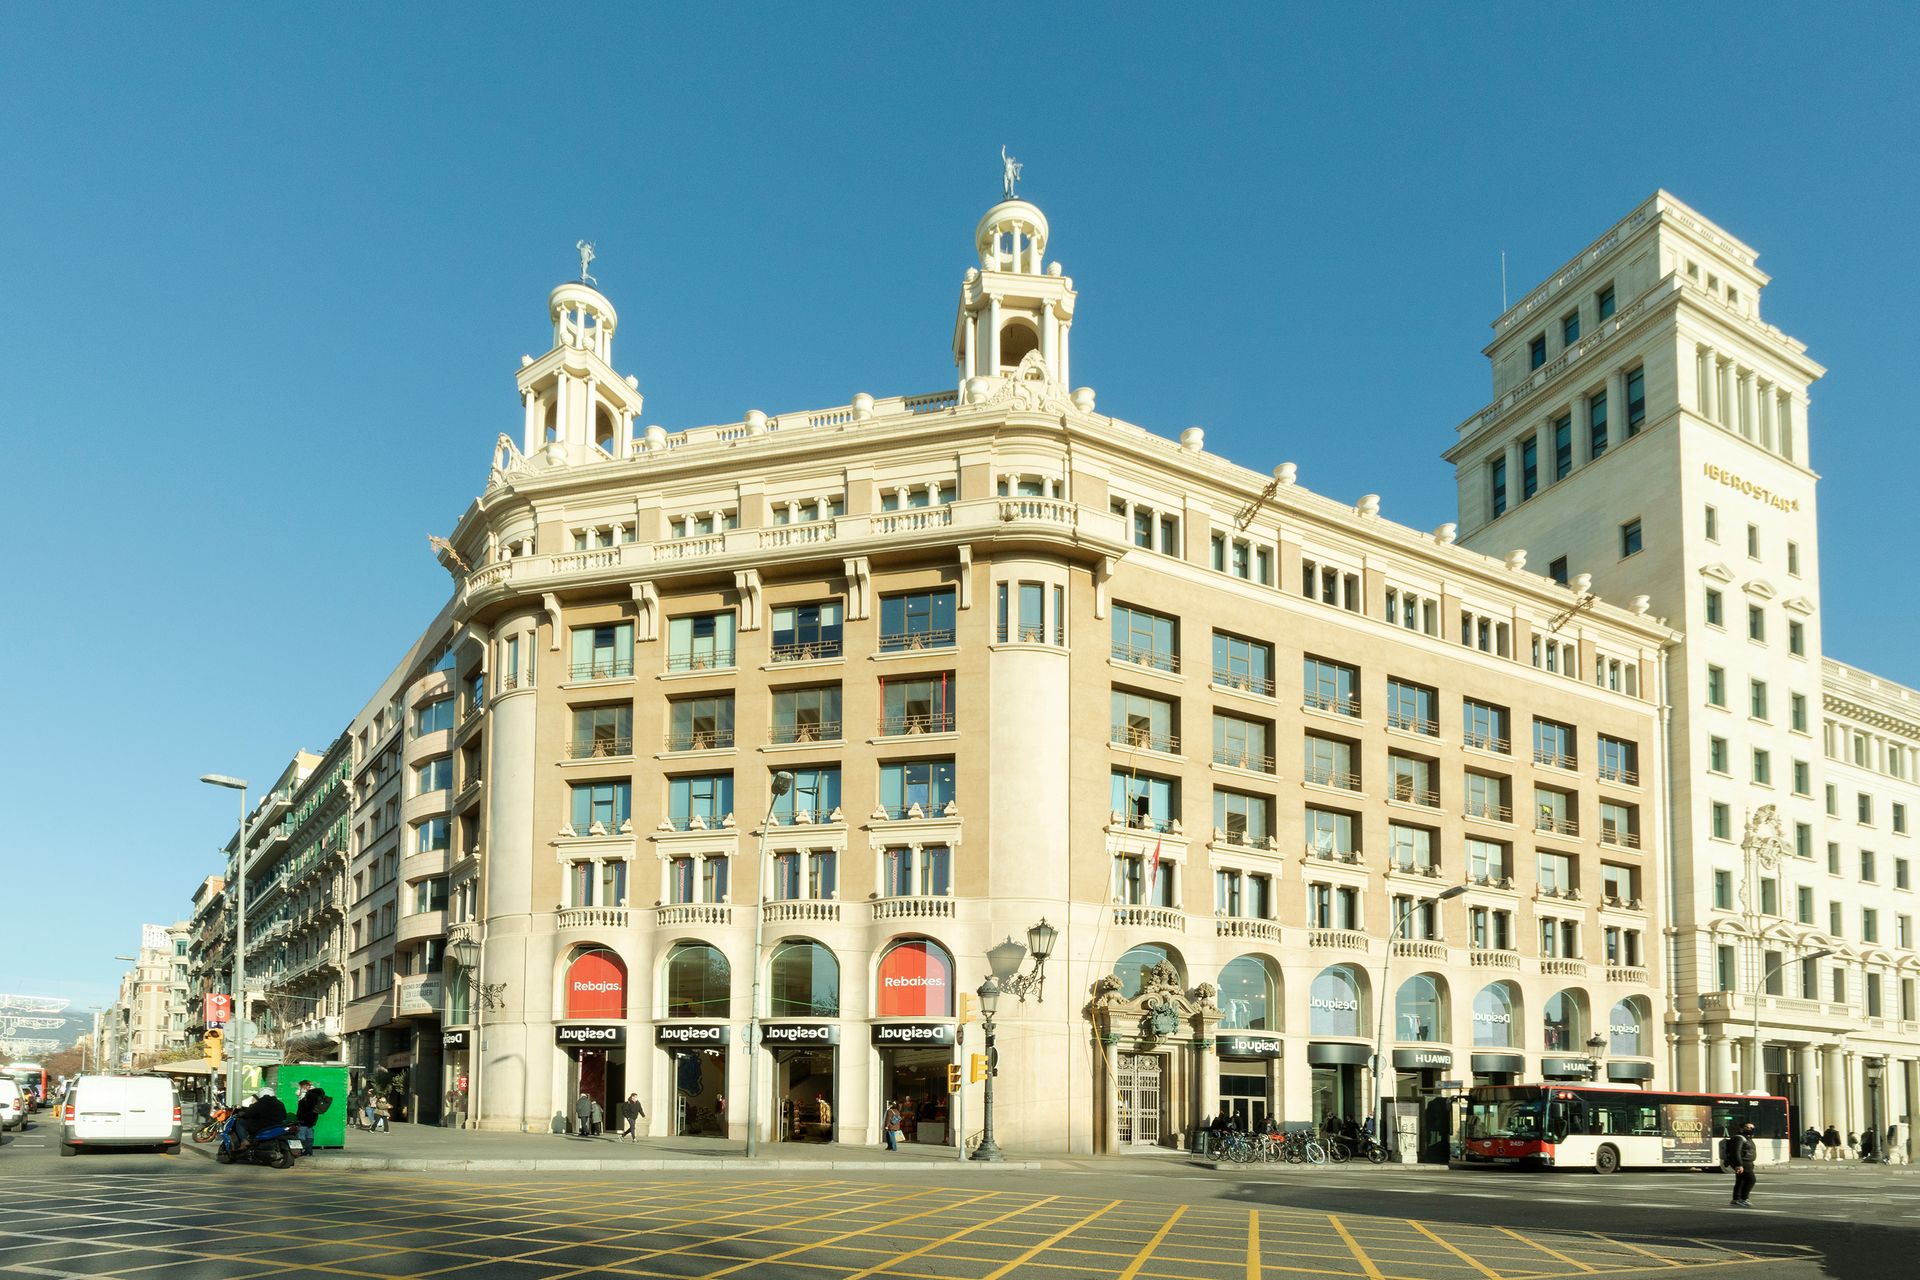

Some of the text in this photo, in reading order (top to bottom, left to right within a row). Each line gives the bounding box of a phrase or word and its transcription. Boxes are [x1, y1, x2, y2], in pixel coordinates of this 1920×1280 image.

[1703, 462, 1790, 513] IBEROSTAR
[574, 981, 622, 993] Rebajas.
[885, 976, 945, 987] Rebaixes.
